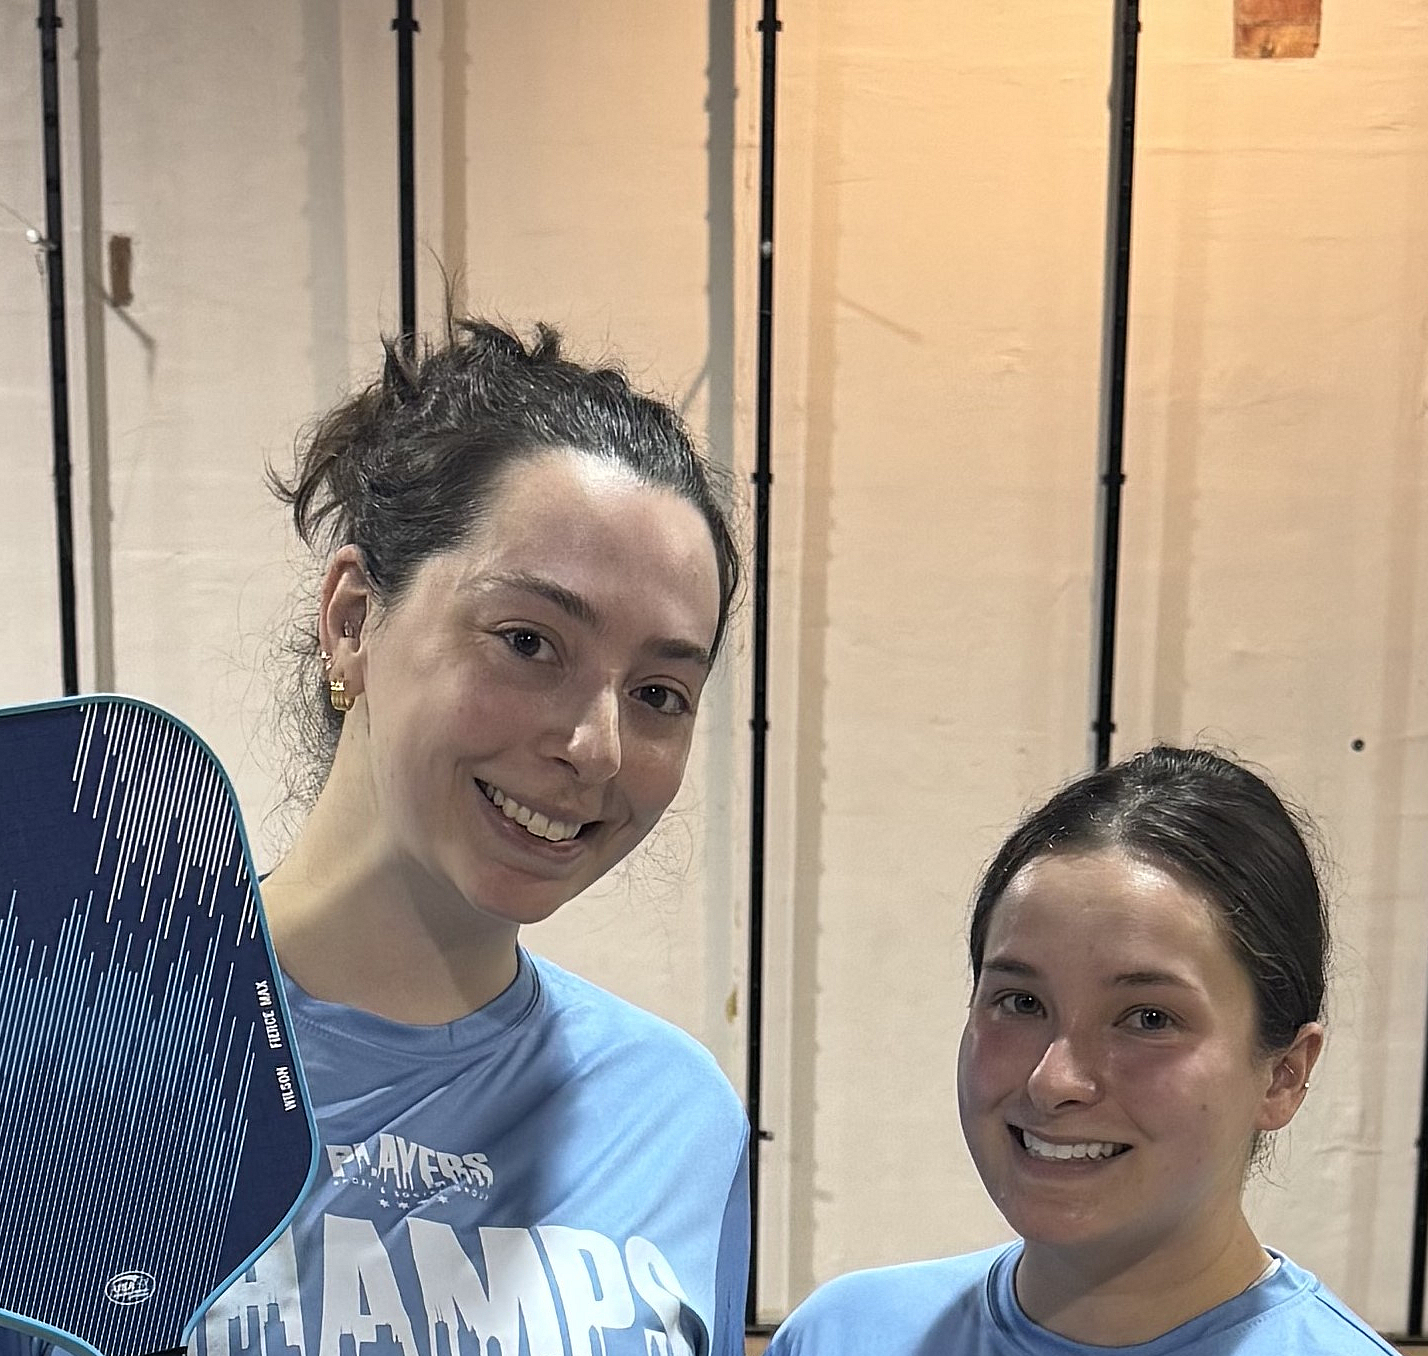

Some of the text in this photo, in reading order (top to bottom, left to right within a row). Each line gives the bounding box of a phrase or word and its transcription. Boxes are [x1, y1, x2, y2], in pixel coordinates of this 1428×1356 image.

[254, 980, 272, 1007] MAX
[275, 1066, 297, 1112] WILSON
[325, 1133, 494, 1190] PLAYERS
